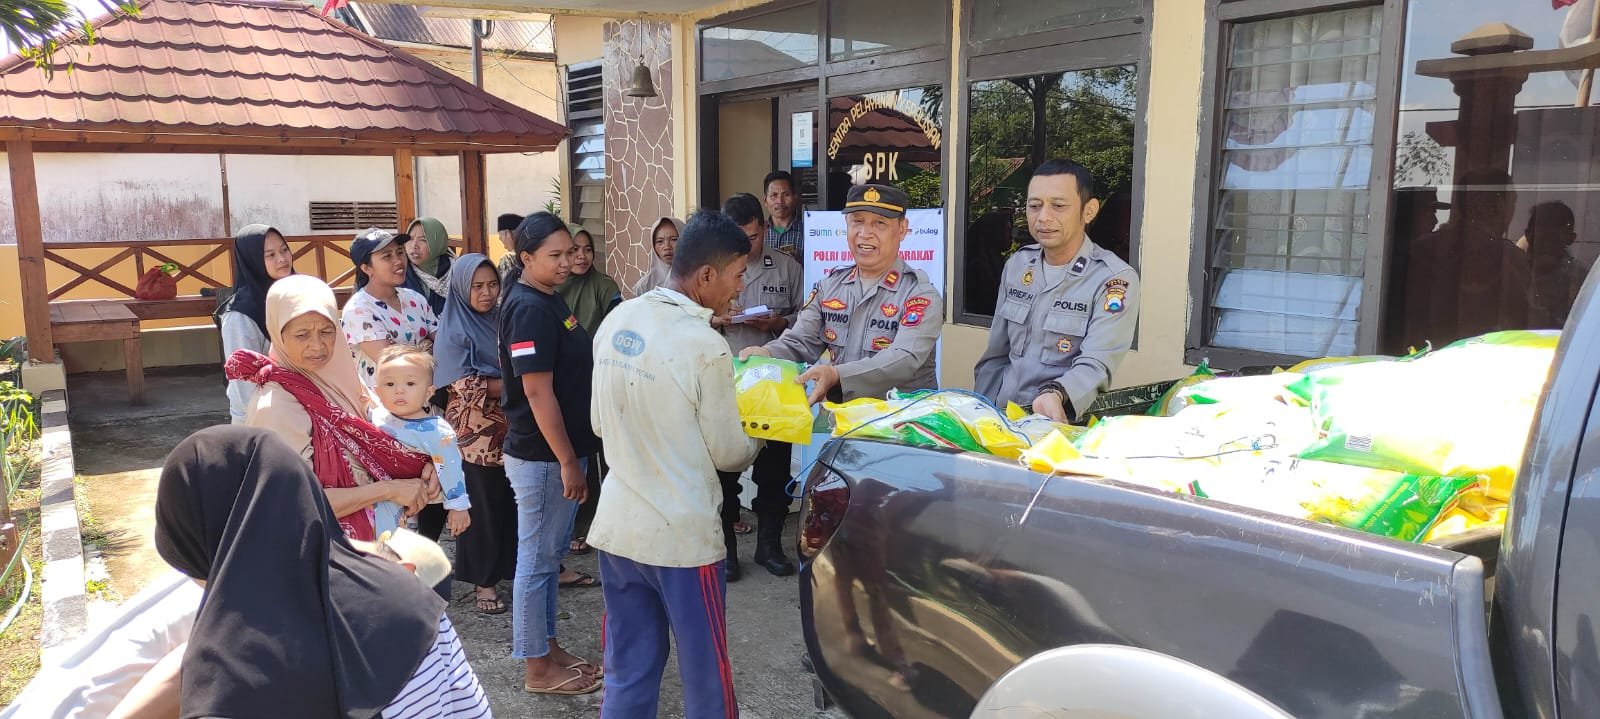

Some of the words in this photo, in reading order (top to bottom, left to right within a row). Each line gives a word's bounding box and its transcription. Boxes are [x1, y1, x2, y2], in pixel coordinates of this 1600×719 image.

[828, 117, 851, 160] SENTRA
[864, 152, 899, 180] SPK
[813, 250, 839, 261] POLRI
[1053, 301, 1088, 312] POLISI
[870, 318, 899, 331] POLR
[616, 335, 642, 350] DGW
